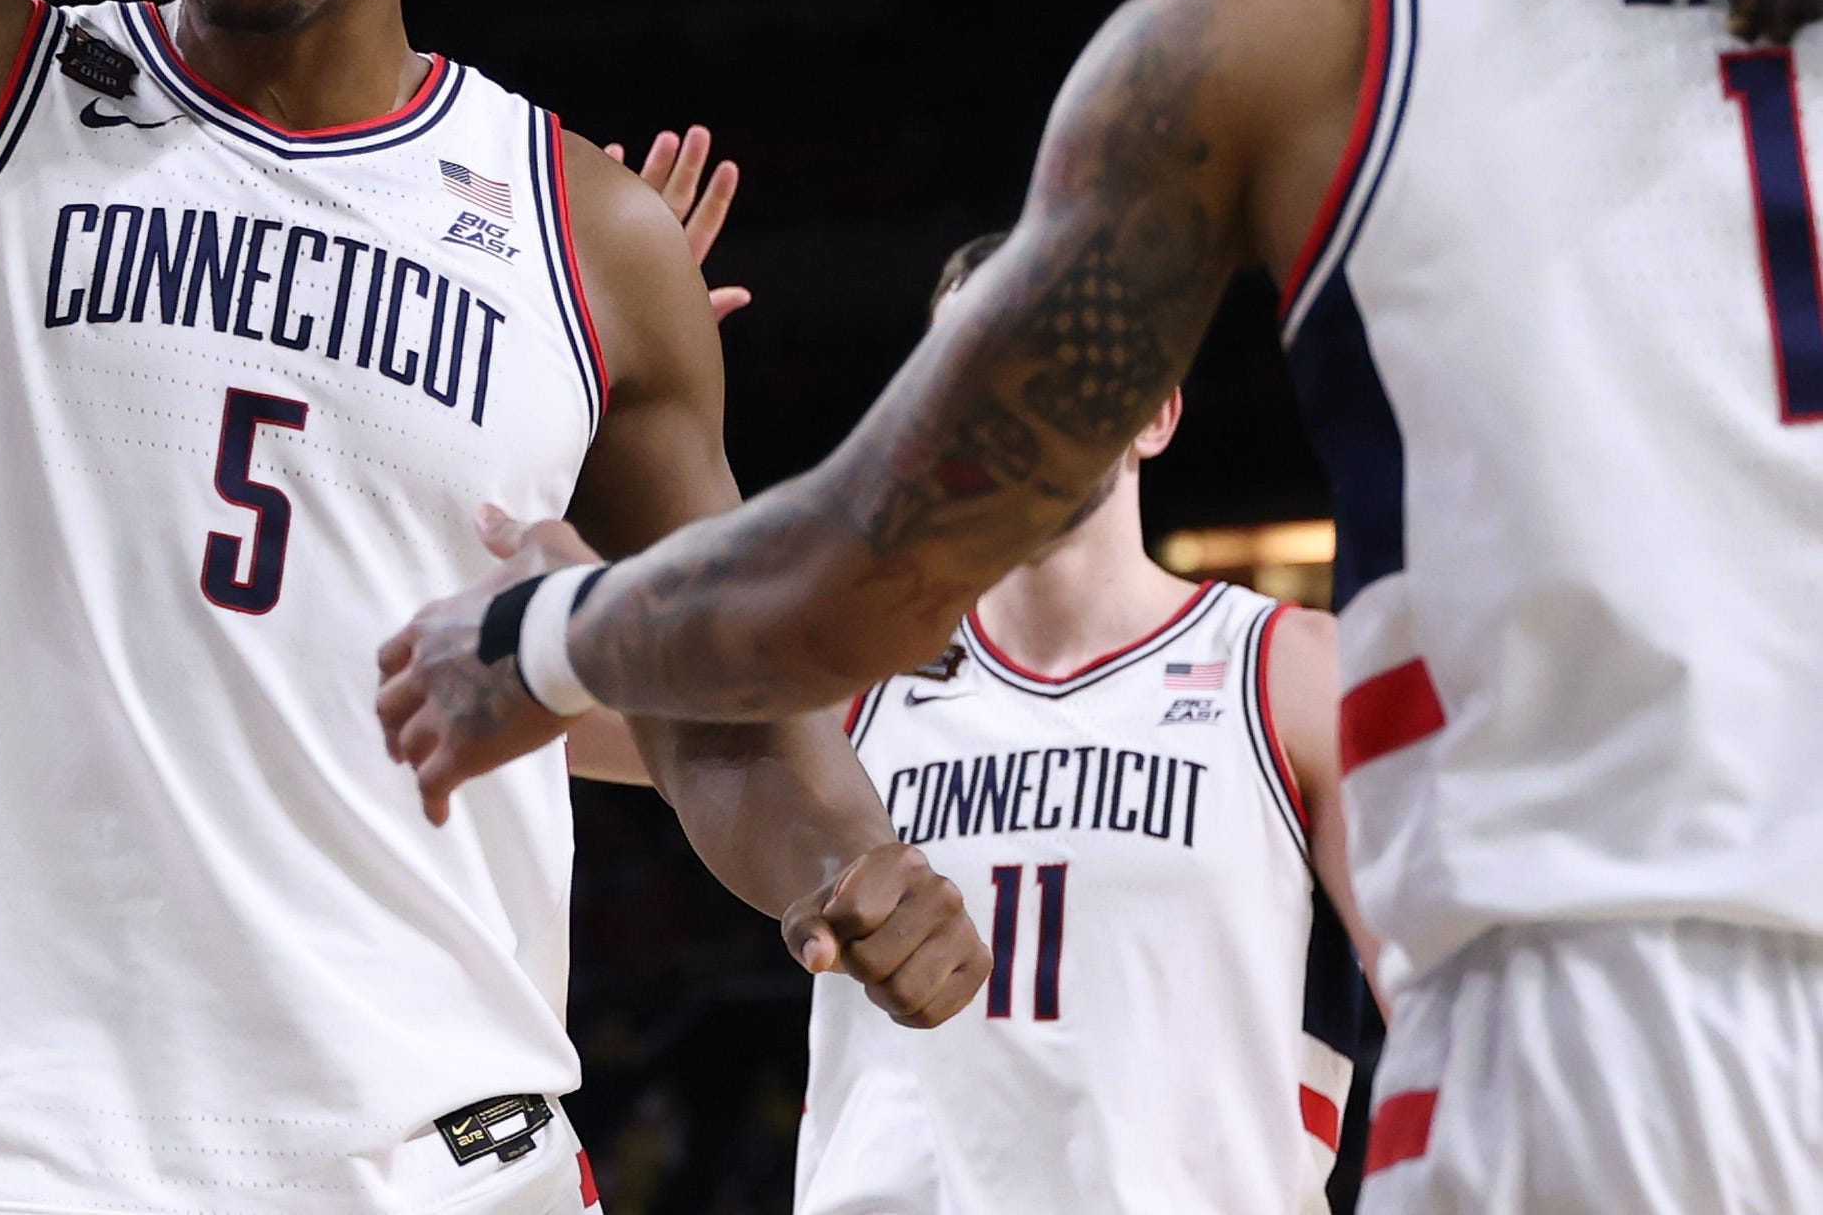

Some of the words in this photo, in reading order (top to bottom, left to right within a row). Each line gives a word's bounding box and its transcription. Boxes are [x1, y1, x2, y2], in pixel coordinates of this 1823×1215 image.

[446, 222, 522, 259] EAST
[456, 210, 510, 239] BIG
[1718, 48, 1823, 424] 1
[44, 203, 507, 429] CONNECTICUT
[200, 386, 310, 617] 5
[887, 745, 1209, 849] CONNECTICUT
[986, 861, 1070, 1022] 11
